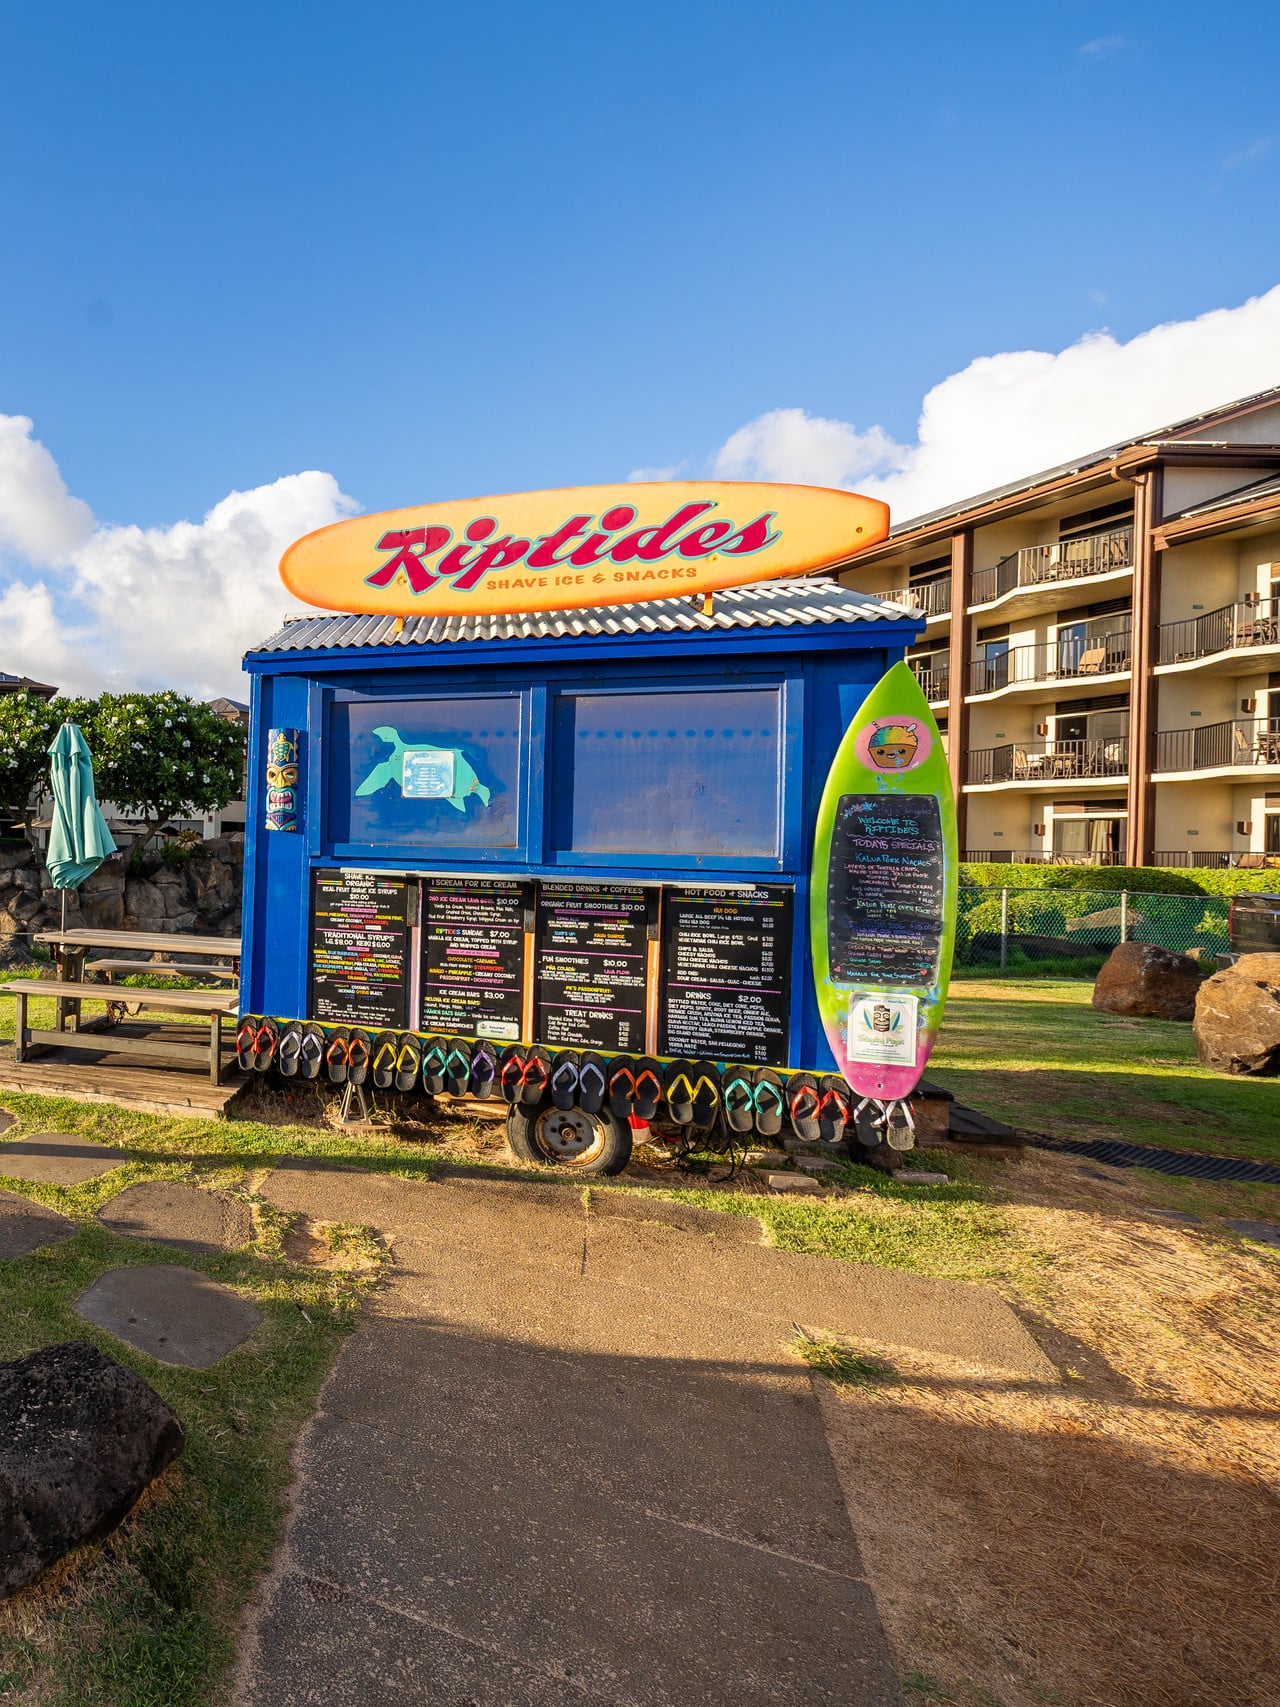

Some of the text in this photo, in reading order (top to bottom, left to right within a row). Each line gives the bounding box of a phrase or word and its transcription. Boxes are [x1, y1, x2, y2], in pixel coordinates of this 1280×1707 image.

[363, 500, 782, 596] Riptides
[485, 566, 697, 591] SHAVE ICE & SNACKS
[858, 816, 899, 825] WELCOME
[865, 824, 919, 835] RIPTIDES
[852, 839, 935, 852] TODAYS SPECIALS
[542, 884, 573, 892] BLENDED
[703, 889, 726, 897] FOOD
[737, 891, 768, 899] SNACKS
[621, 903, 645, 911] $10.00
[323, 931, 366, 939] TRADITIONAL
[490, 930, 510, 938] $7.00
[555, 956, 589, 964] SMOOTHIES
[484, 991, 504, 999] $3.00
[685, 991, 761, 1003] DRINKS $2.00
[589, 1011, 613, 1019] DRINKS
